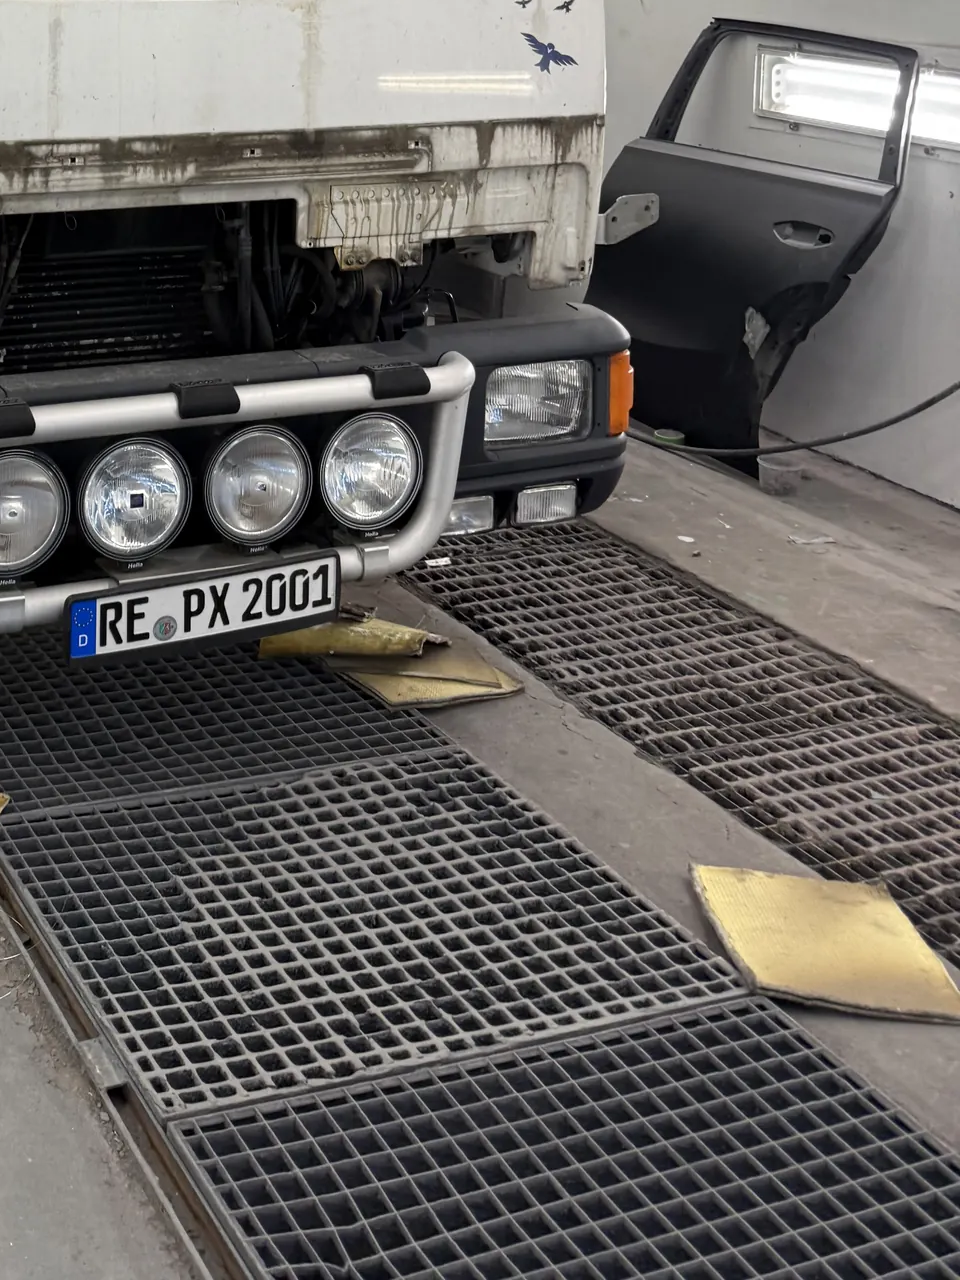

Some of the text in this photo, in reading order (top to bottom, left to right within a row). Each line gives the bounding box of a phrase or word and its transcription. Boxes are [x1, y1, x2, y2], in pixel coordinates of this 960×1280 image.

[100, 564, 330, 647] RE PX 2001
[78, 634, 88, 647] D
